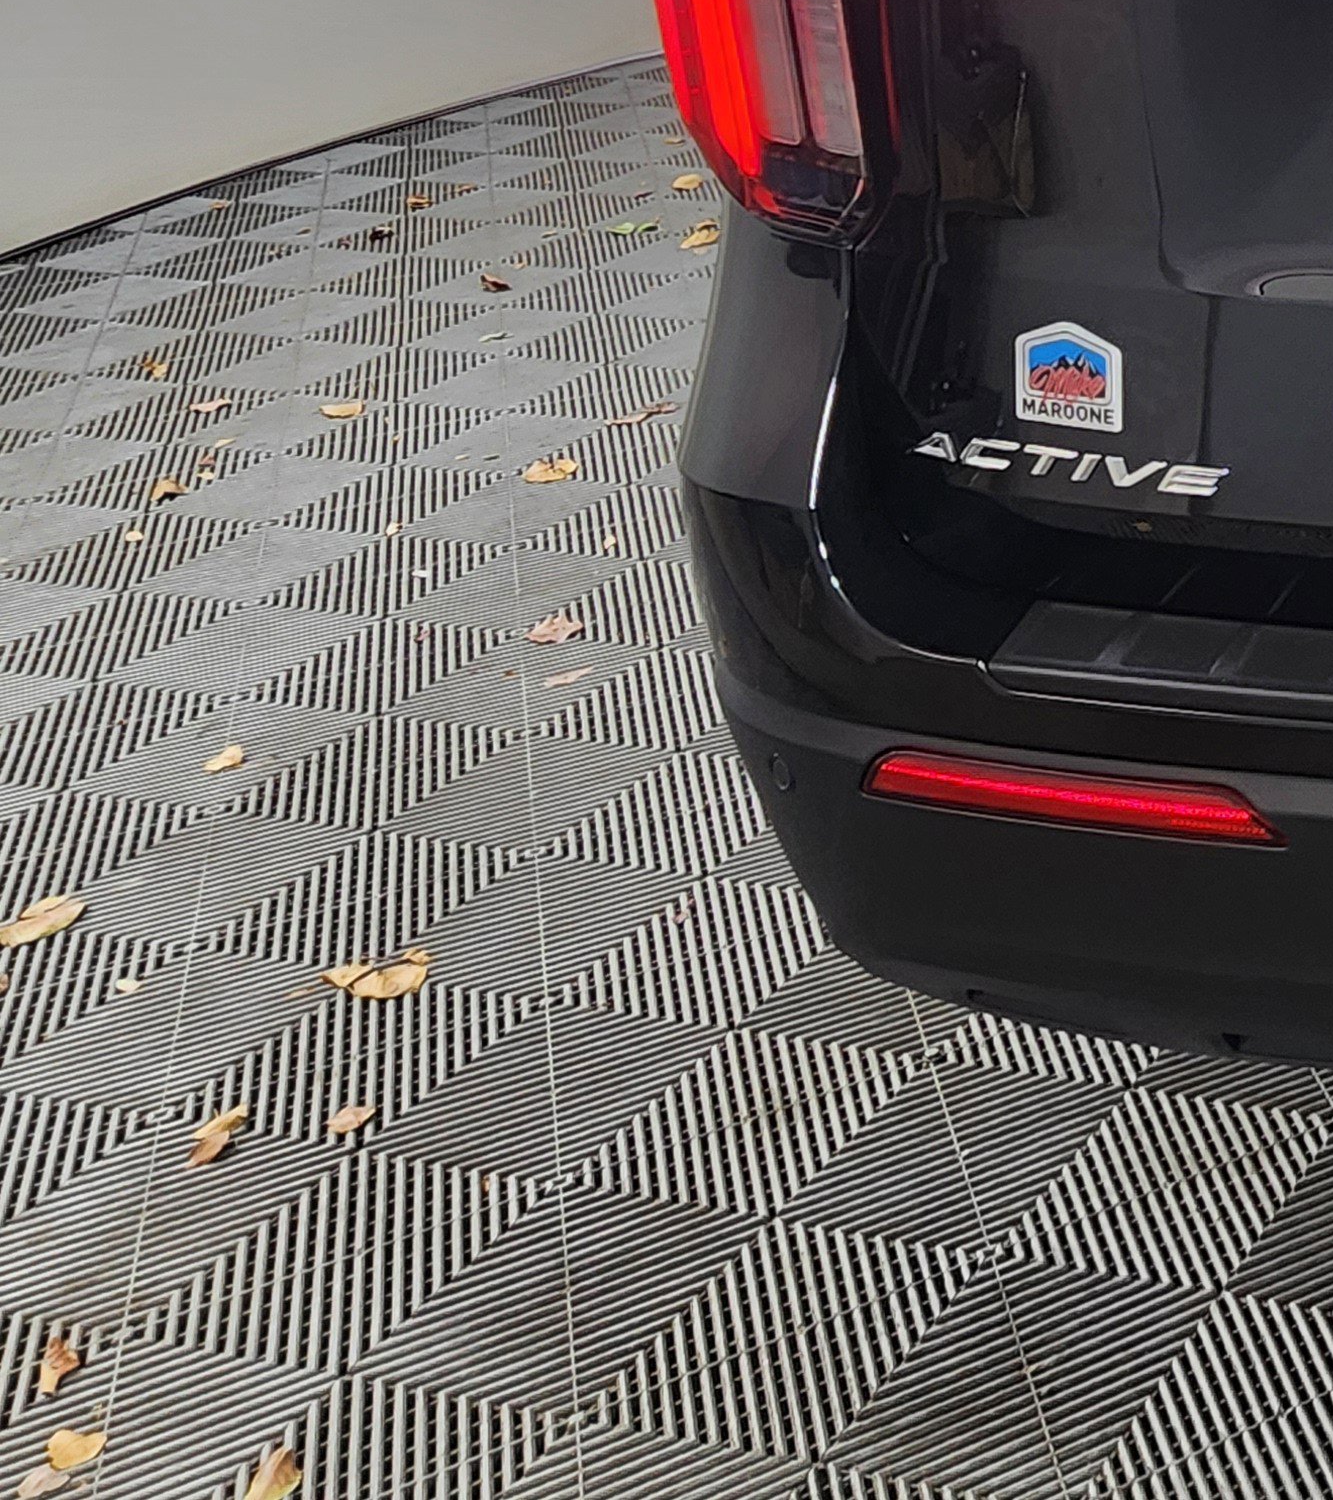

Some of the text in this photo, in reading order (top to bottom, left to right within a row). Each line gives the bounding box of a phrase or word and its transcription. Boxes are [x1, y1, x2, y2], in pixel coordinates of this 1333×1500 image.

[1029, 364, 1107, 404] Mike
[1022, 398, 1115, 425] MAROONE
[907, 431, 1231, 497] ACTIVE
